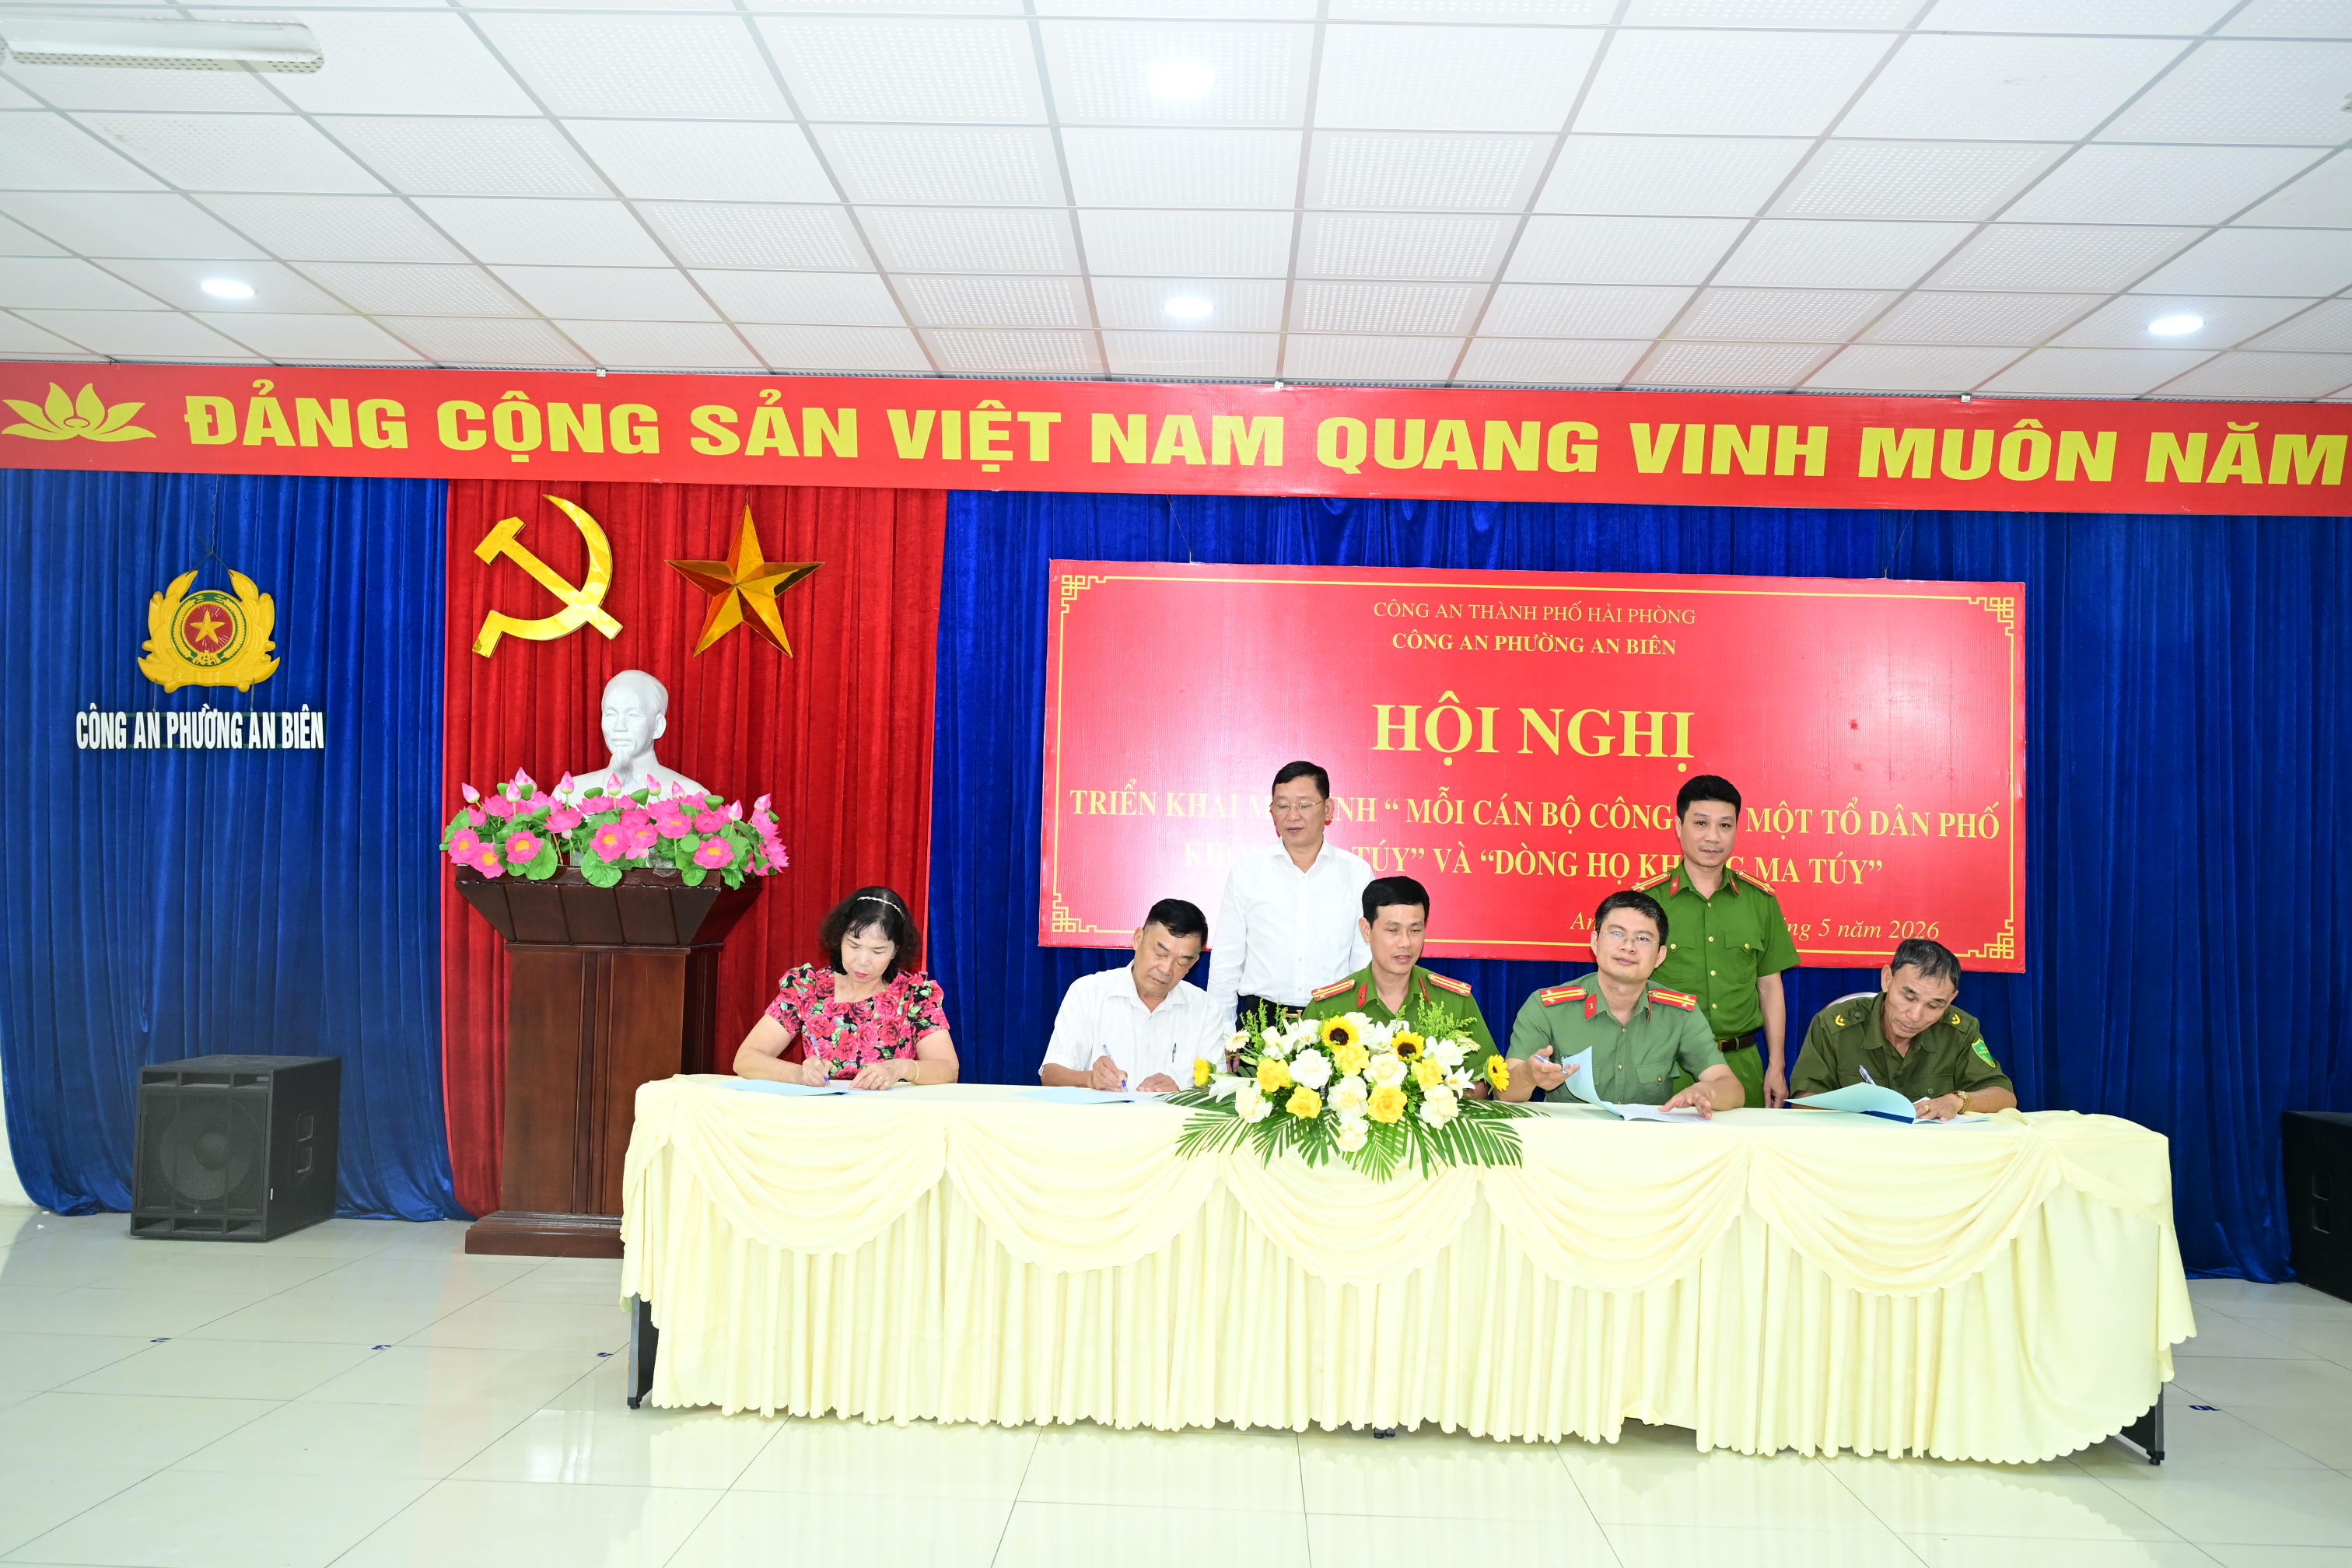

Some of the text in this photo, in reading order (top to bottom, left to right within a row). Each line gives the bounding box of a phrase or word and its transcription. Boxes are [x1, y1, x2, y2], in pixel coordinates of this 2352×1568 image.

[184, 379, 2348, 485] ĐẢNG CỘNG SẢN VIỆT NAM QUANG VINH MUÔN NĂM
[1373, 598, 1696, 625] CÔNG AN THÀNH PHỐ HẢI PHÒNG
[1392, 628, 1677, 655] CÔNG AN PHƯỜNG AN BIÊN
[76, 702, 324, 749] CÔNG AN PHƯỜNG AN BIÊN
[1372, 690, 1696, 772] HỘI NGHỊ
[1069, 778, 1157, 816] TRIỂN
[1165, 792, 1239, 818] KHAI
[1405, 786, 1465, 824] MỖI
[1472, 792, 1534, 826] CÁN
[1541, 794, 1581, 835] BỘ
[1589, 796, 1674, 831] CÔNG
[1745, 800, 1815, 841] MỘT
[1821, 796, 1863, 835] TỔ
[1869, 803, 1930, 838] DÂN
[1938, 801, 2001, 839] PHỐ
[1352, 838, 1426, 873] TÚY”
[1433, 841, 1472, 874] VÀ
[1480, 842, 1579, 878] “DÒNG
[1586, 852, 1631, 885] HỌ
[1754, 856, 1801, 884] MA
[1808, 852, 1884, 885] TÚY”
[1818, 918, 1832, 937] 5
[1837, 920, 1881, 939] năm
[1888, 920, 1941, 940] 2026
